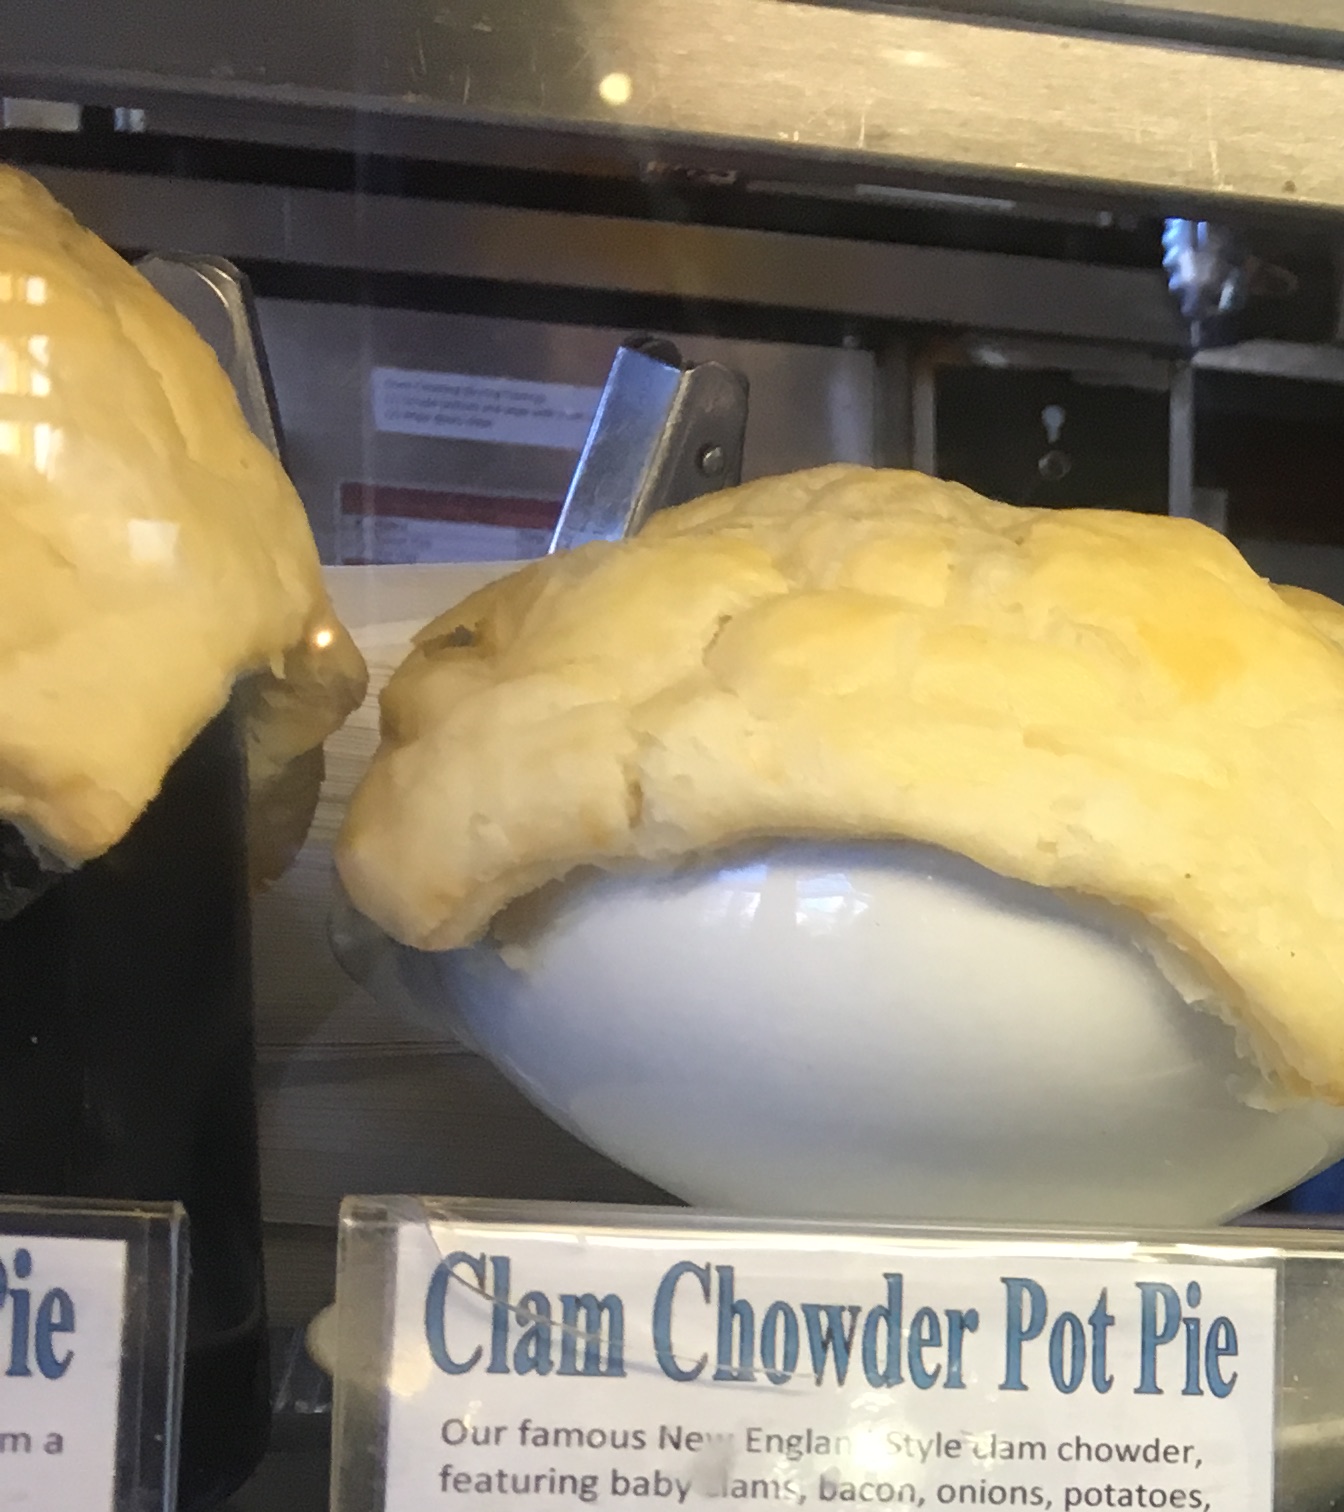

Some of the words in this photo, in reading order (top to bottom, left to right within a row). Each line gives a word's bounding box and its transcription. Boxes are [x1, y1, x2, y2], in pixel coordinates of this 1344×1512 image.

[0, 1249, 76, 1380] ie
[425, 1251, 627, 1378] Clam
[652, 1261, 980, 1390] Chowder
[1000, 1276, 1116, 1397] Pot
[1135, 1280, 1239, 1399] Pie
[43, 1432, 64, 1454] a
[441, 1418, 507, 1447] Our
[519, 1418, 646, 1449] famous
[745, 1427, 860, 1460] Englan
[886, 1430, 962, 1463] Style
[1057, 1435, 1203, 1468] chowder,
[439, 1464, 599, 1502] featuring
[610, 1468, 692, 1503] baby
[818, 1473, 926, 1507] bacon,
[937, 1478, 1053, 1510] onions,
[1064, 1483, 1211, 1512] potatoes,
